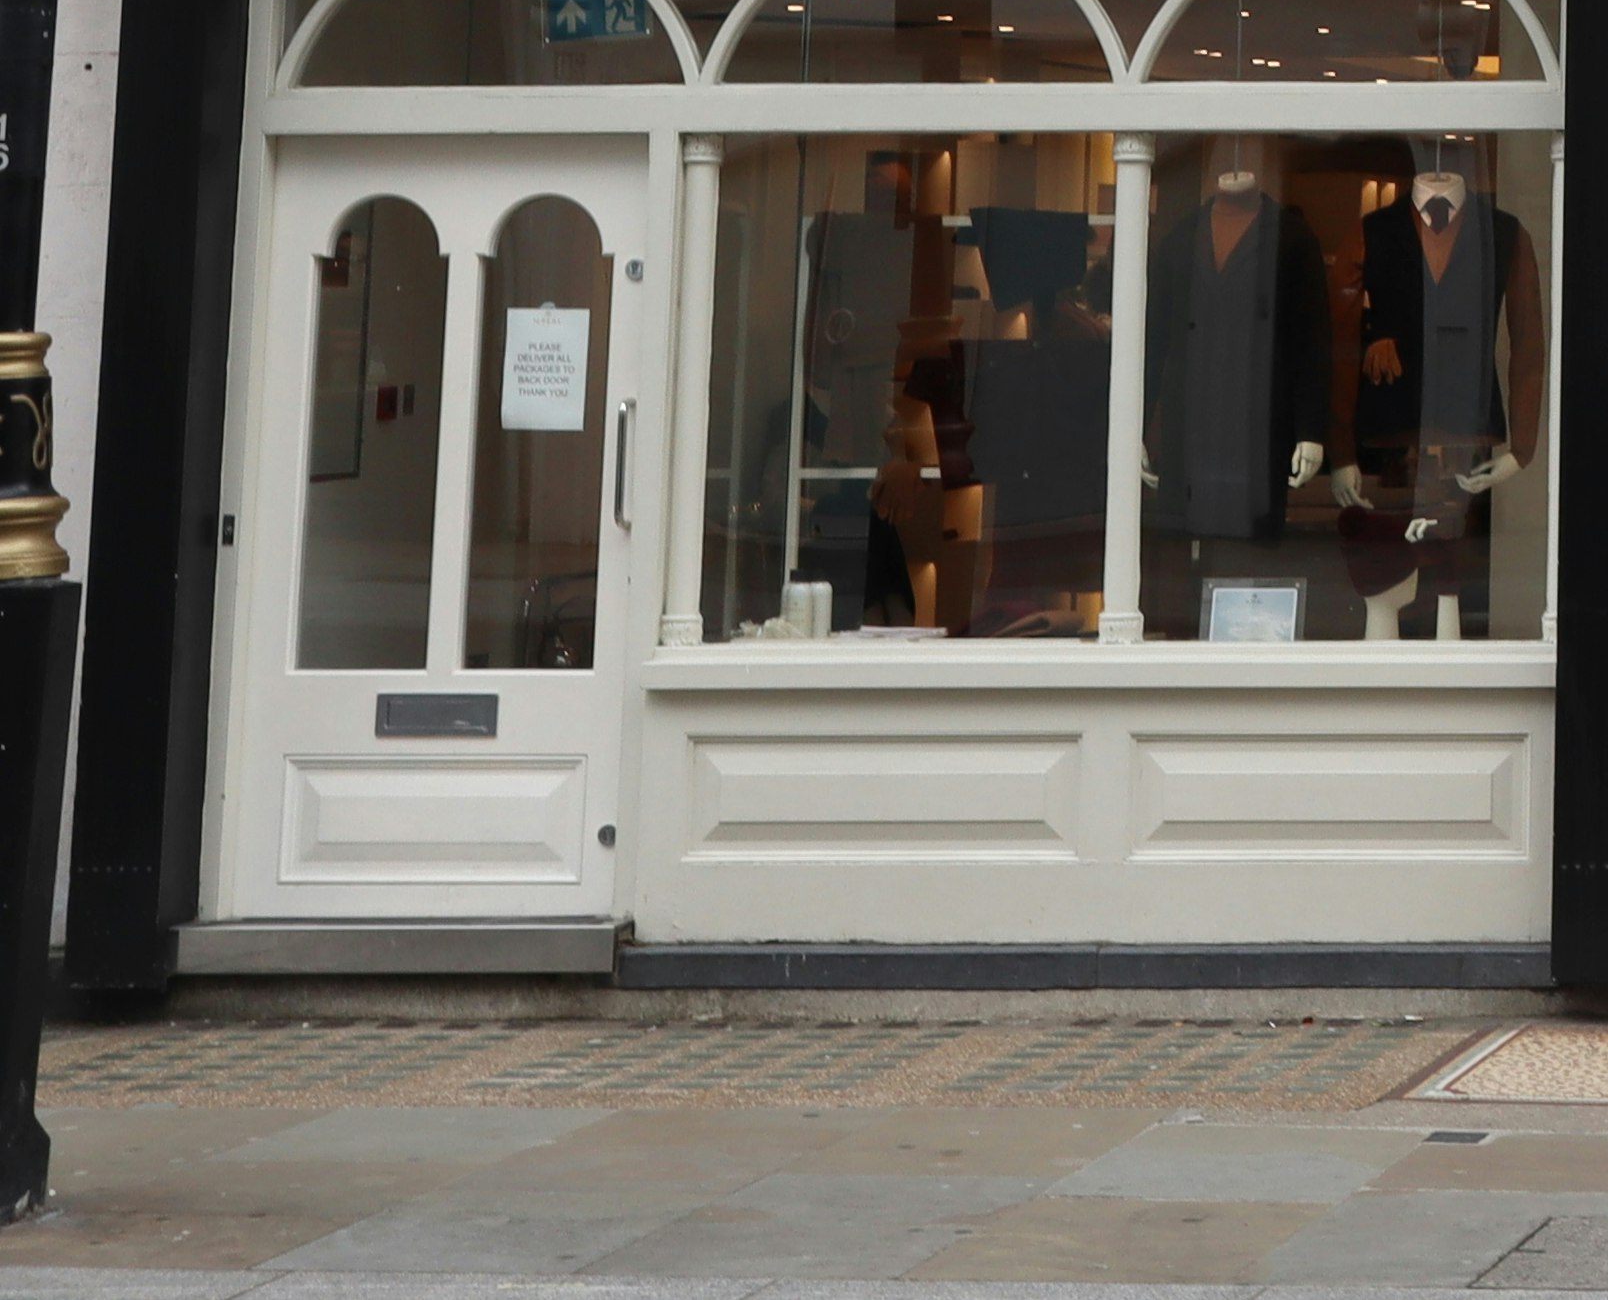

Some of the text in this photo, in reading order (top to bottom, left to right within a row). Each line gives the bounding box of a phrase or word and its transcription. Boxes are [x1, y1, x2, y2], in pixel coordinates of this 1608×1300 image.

[528, 343, 561, 351] PLEASE
[517, 353, 571, 363] DELIVER ALL
[513, 364, 575, 374] PACKAGES TO
[517, 375, 569, 384] BACK DOOR
[519, 388, 568, 398] THANK YOU
